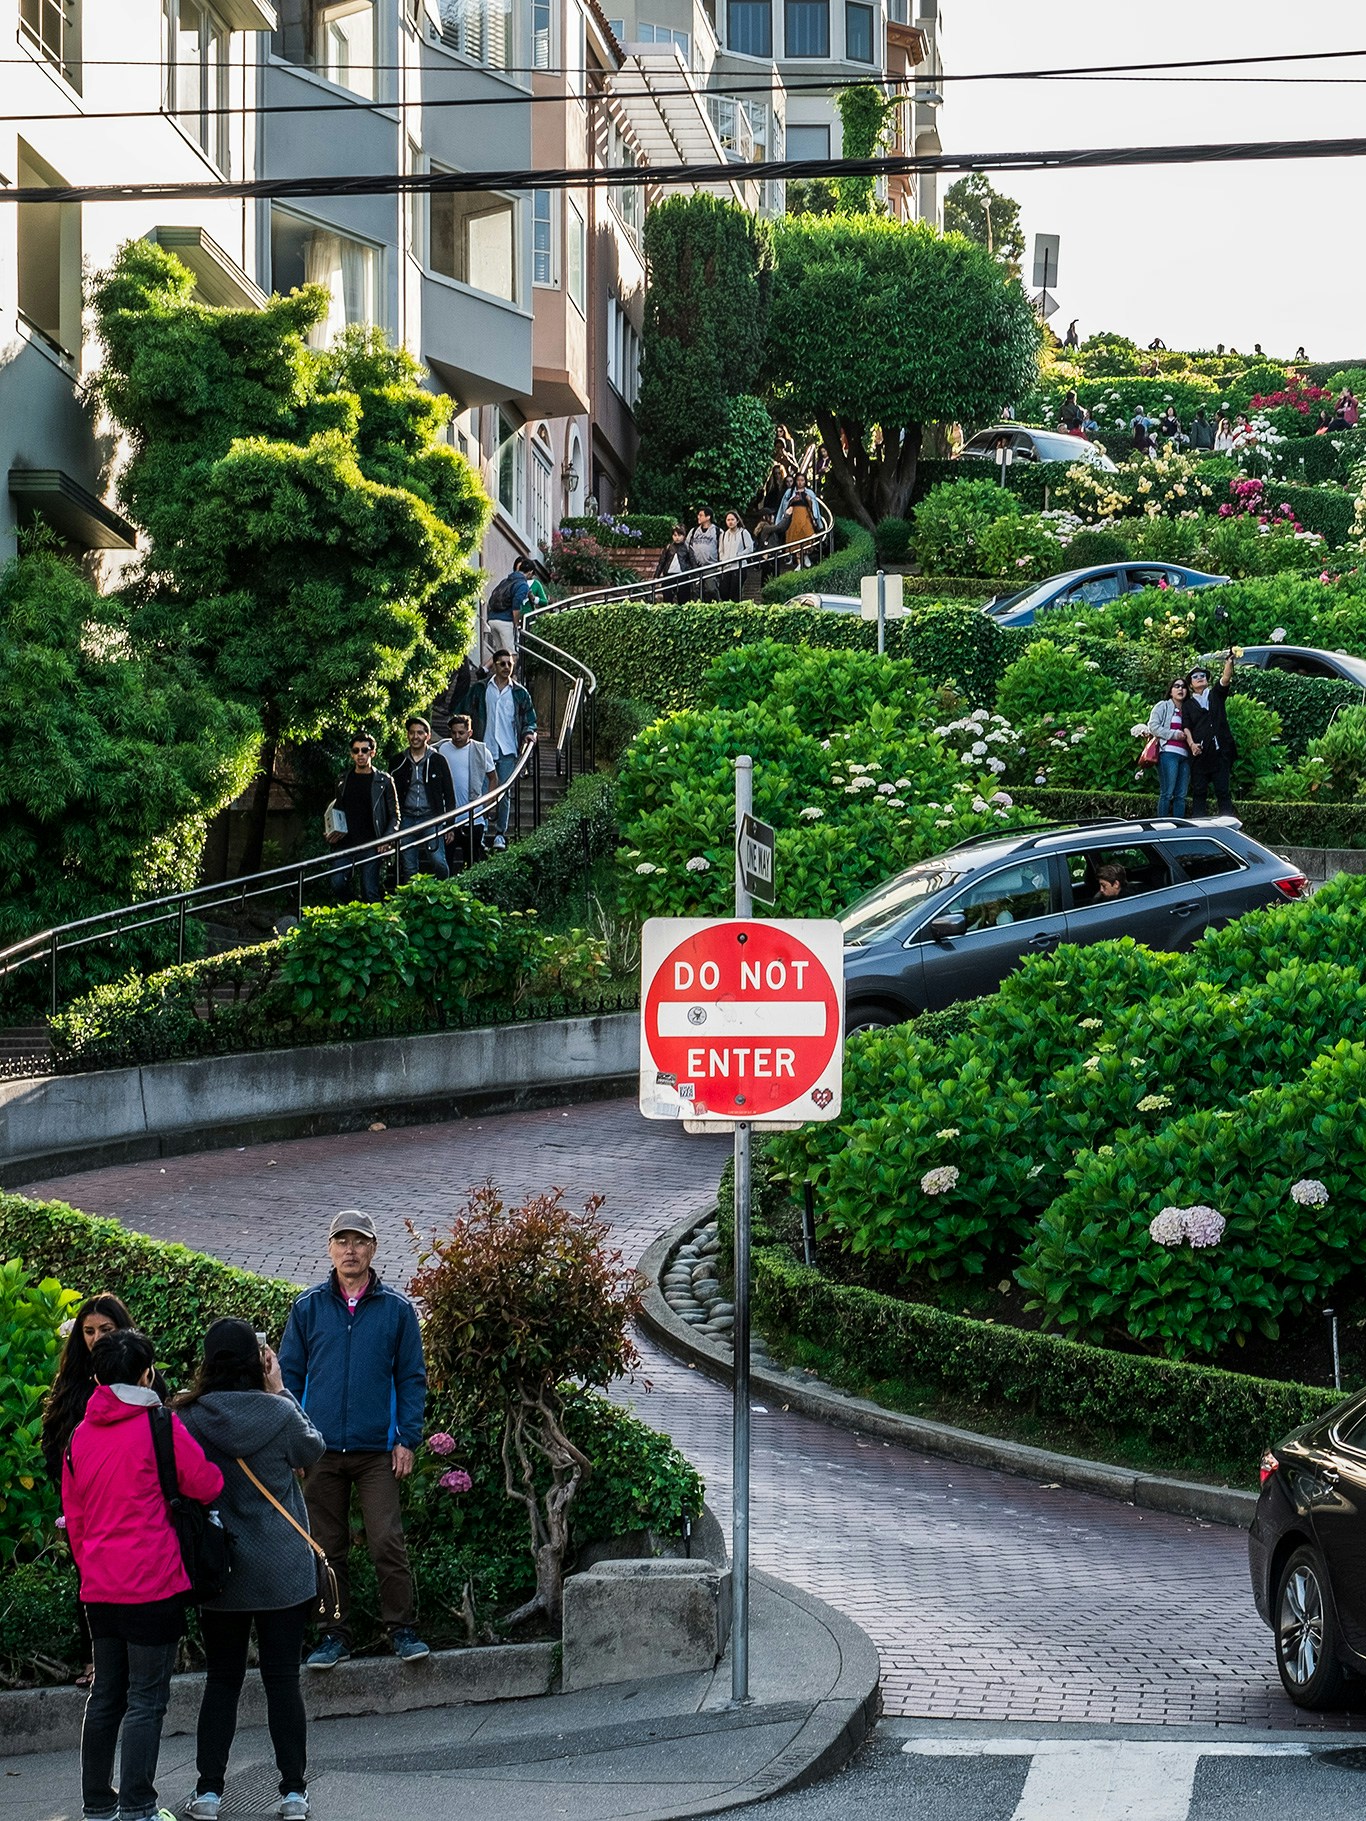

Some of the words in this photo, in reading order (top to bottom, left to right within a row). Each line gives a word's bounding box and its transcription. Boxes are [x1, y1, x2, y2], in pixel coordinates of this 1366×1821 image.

[746, 839, 757, 872] ONE
[758, 845, 770, 878] WAY
[674, 961, 720, 991] DO
[741, 961, 809, 991] NOT
[687, 1048, 796, 1078] ENTER
